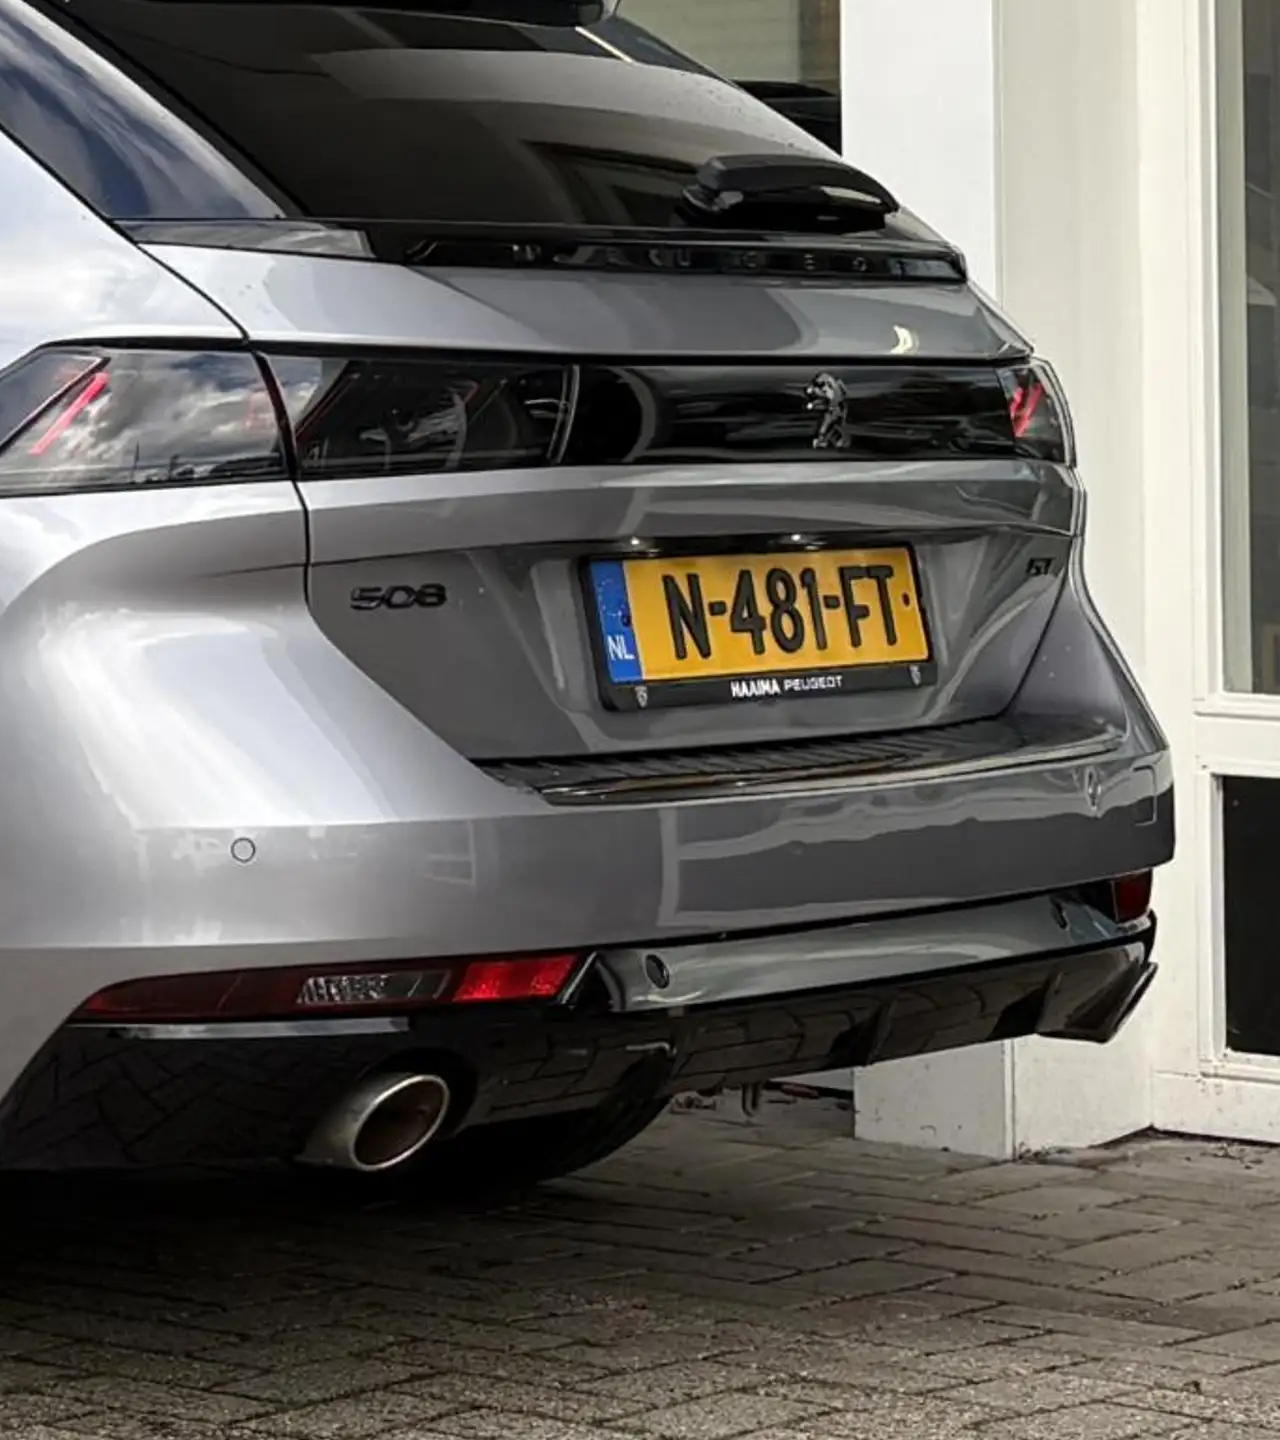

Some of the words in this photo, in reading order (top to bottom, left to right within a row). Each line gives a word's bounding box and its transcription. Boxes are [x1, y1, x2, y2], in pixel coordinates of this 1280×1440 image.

[350, 583, 447, 610] 508
[661, 564, 897, 660] N-481-FT
[607, 635, 635, 661] NL
[730, 676, 781, 698] HAAIMA
[784, 675, 843, 692] PEUGEOT
